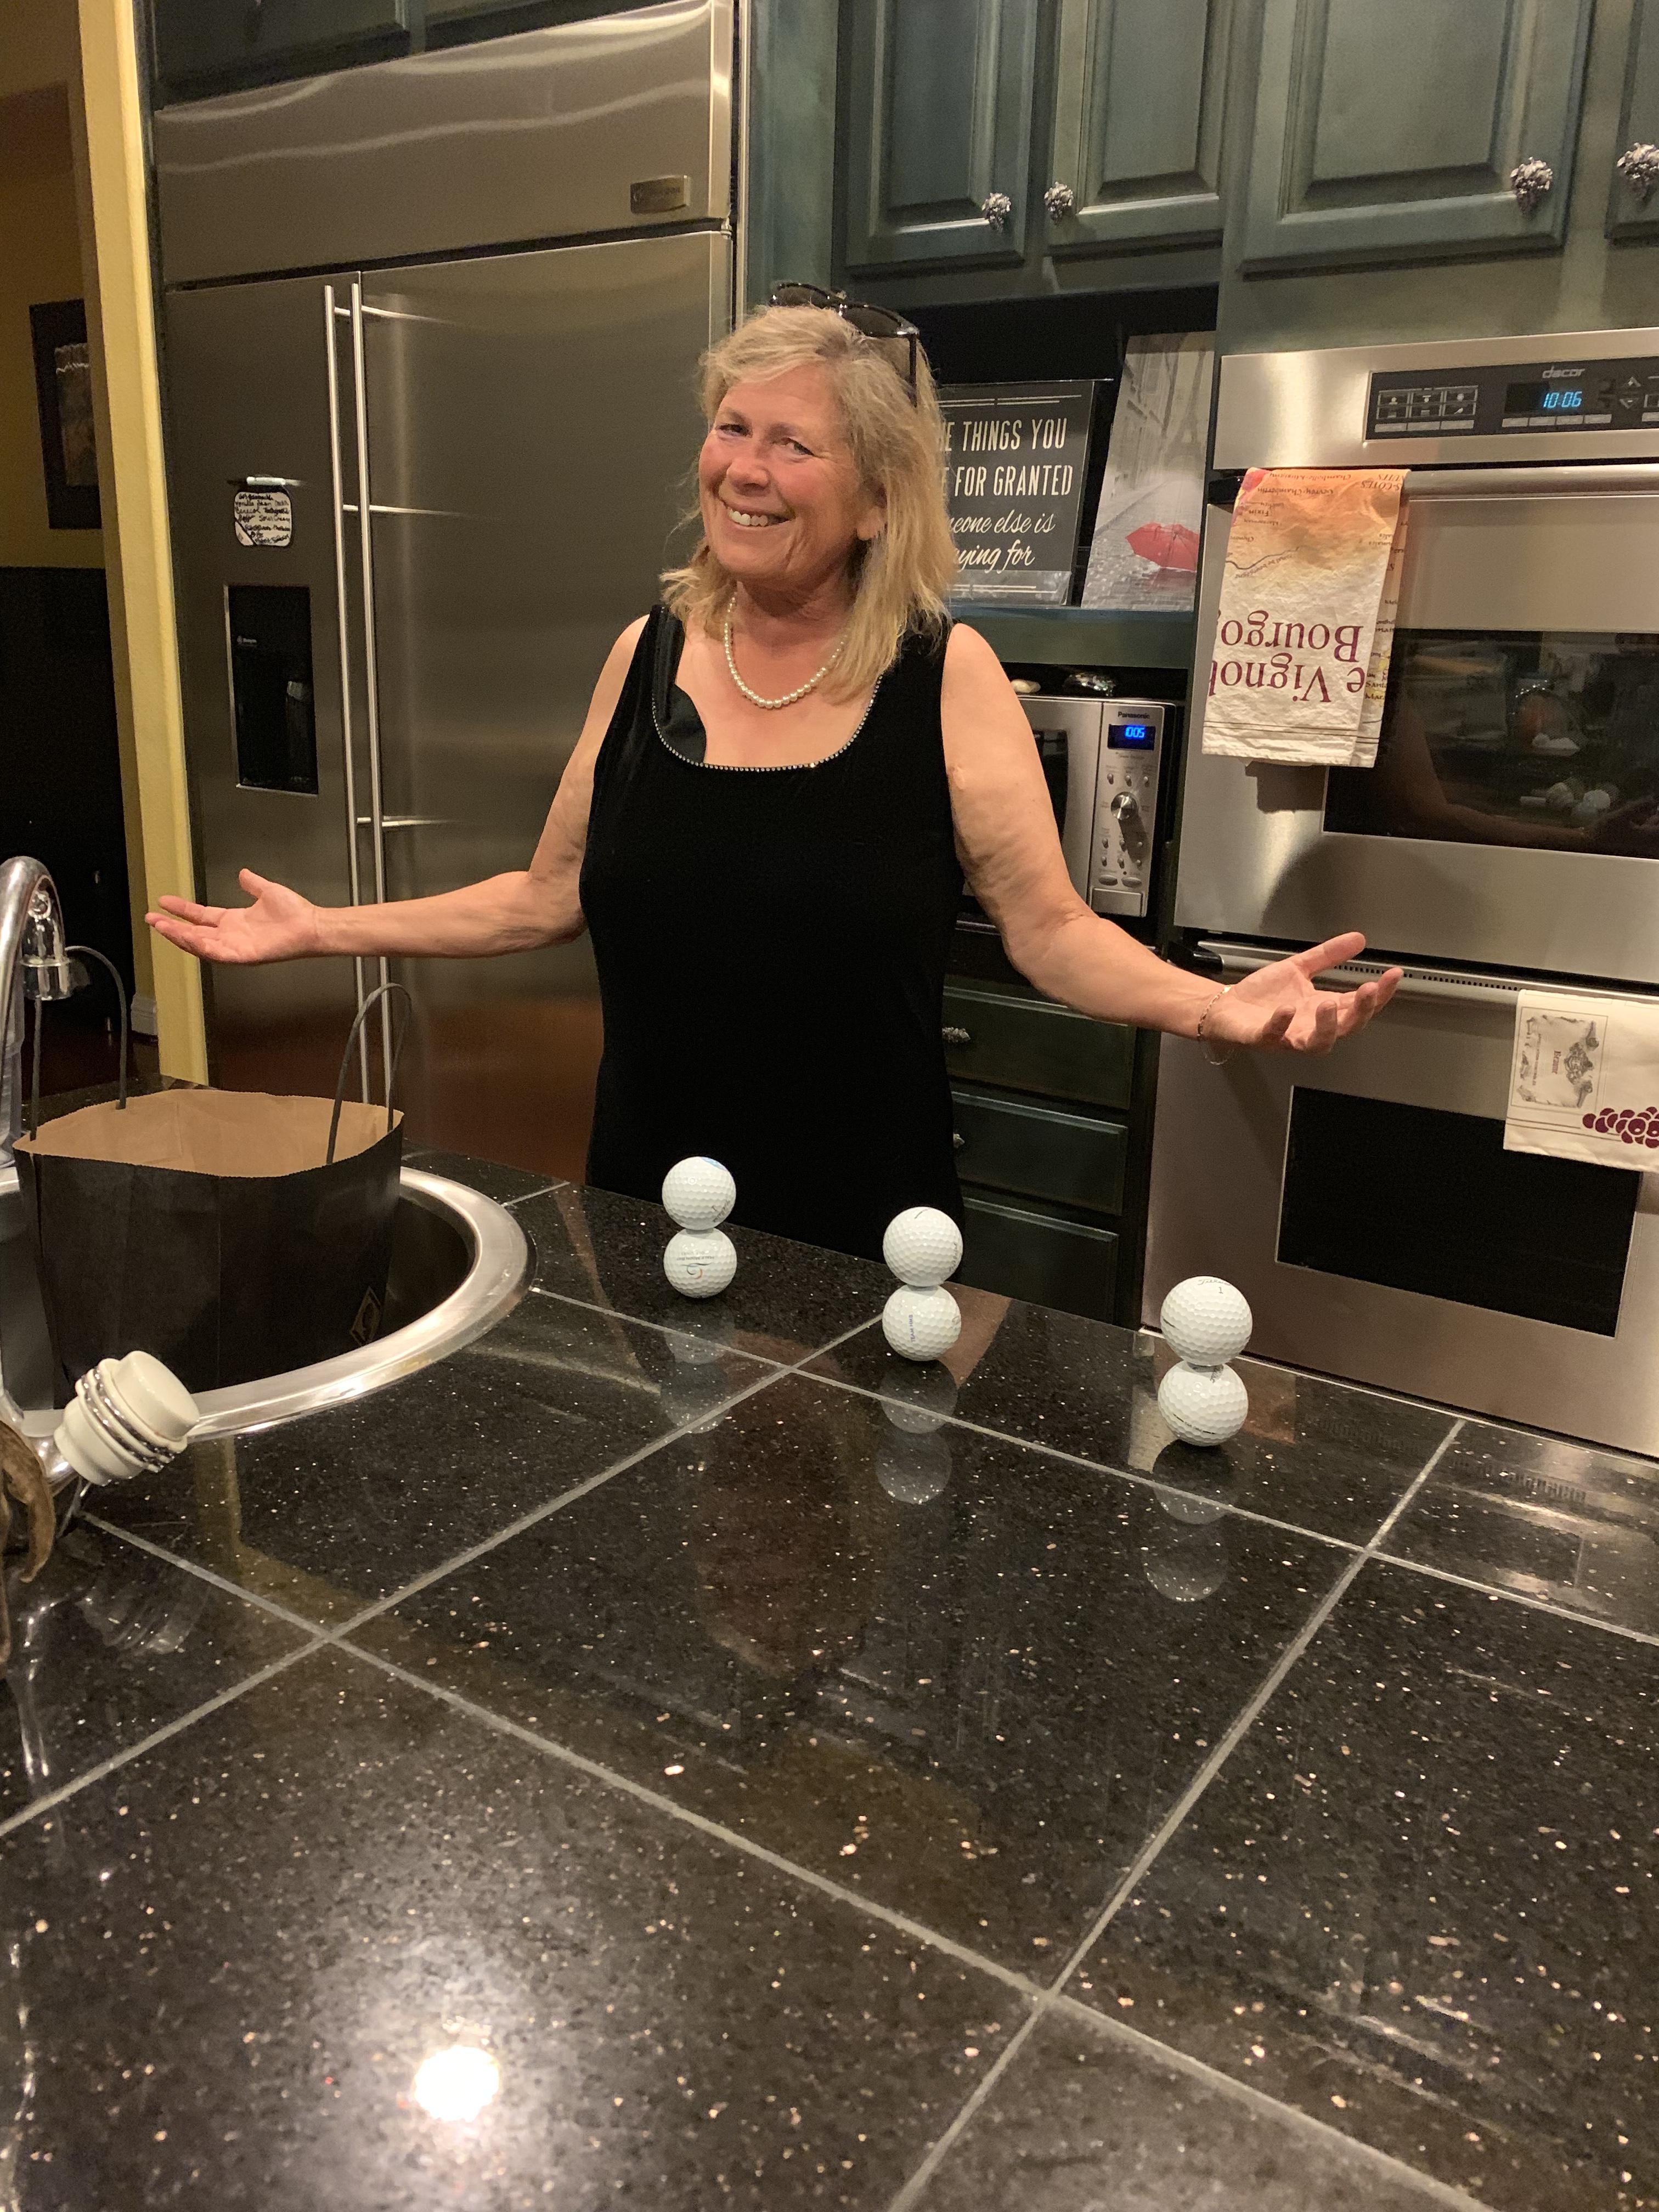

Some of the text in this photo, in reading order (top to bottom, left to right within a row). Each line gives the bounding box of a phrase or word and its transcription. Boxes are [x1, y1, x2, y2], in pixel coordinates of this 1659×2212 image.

[1542, 366, 1585, 379] dacor
[1543, 391, 1582, 409] 10:06
[962, 419, 1022, 452] THINGS
[1031, 417, 1067, 449] YOU
[954, 466, 987, 496] FOR
[993, 465, 1073, 496] GRANTED
[949, 509, 1056, 533] eone else is
[956, 539, 1036, 574] ying for
[1217, 610, 1364, 662] Bourgo
[1118, 711, 1150, 719] Panasonic
